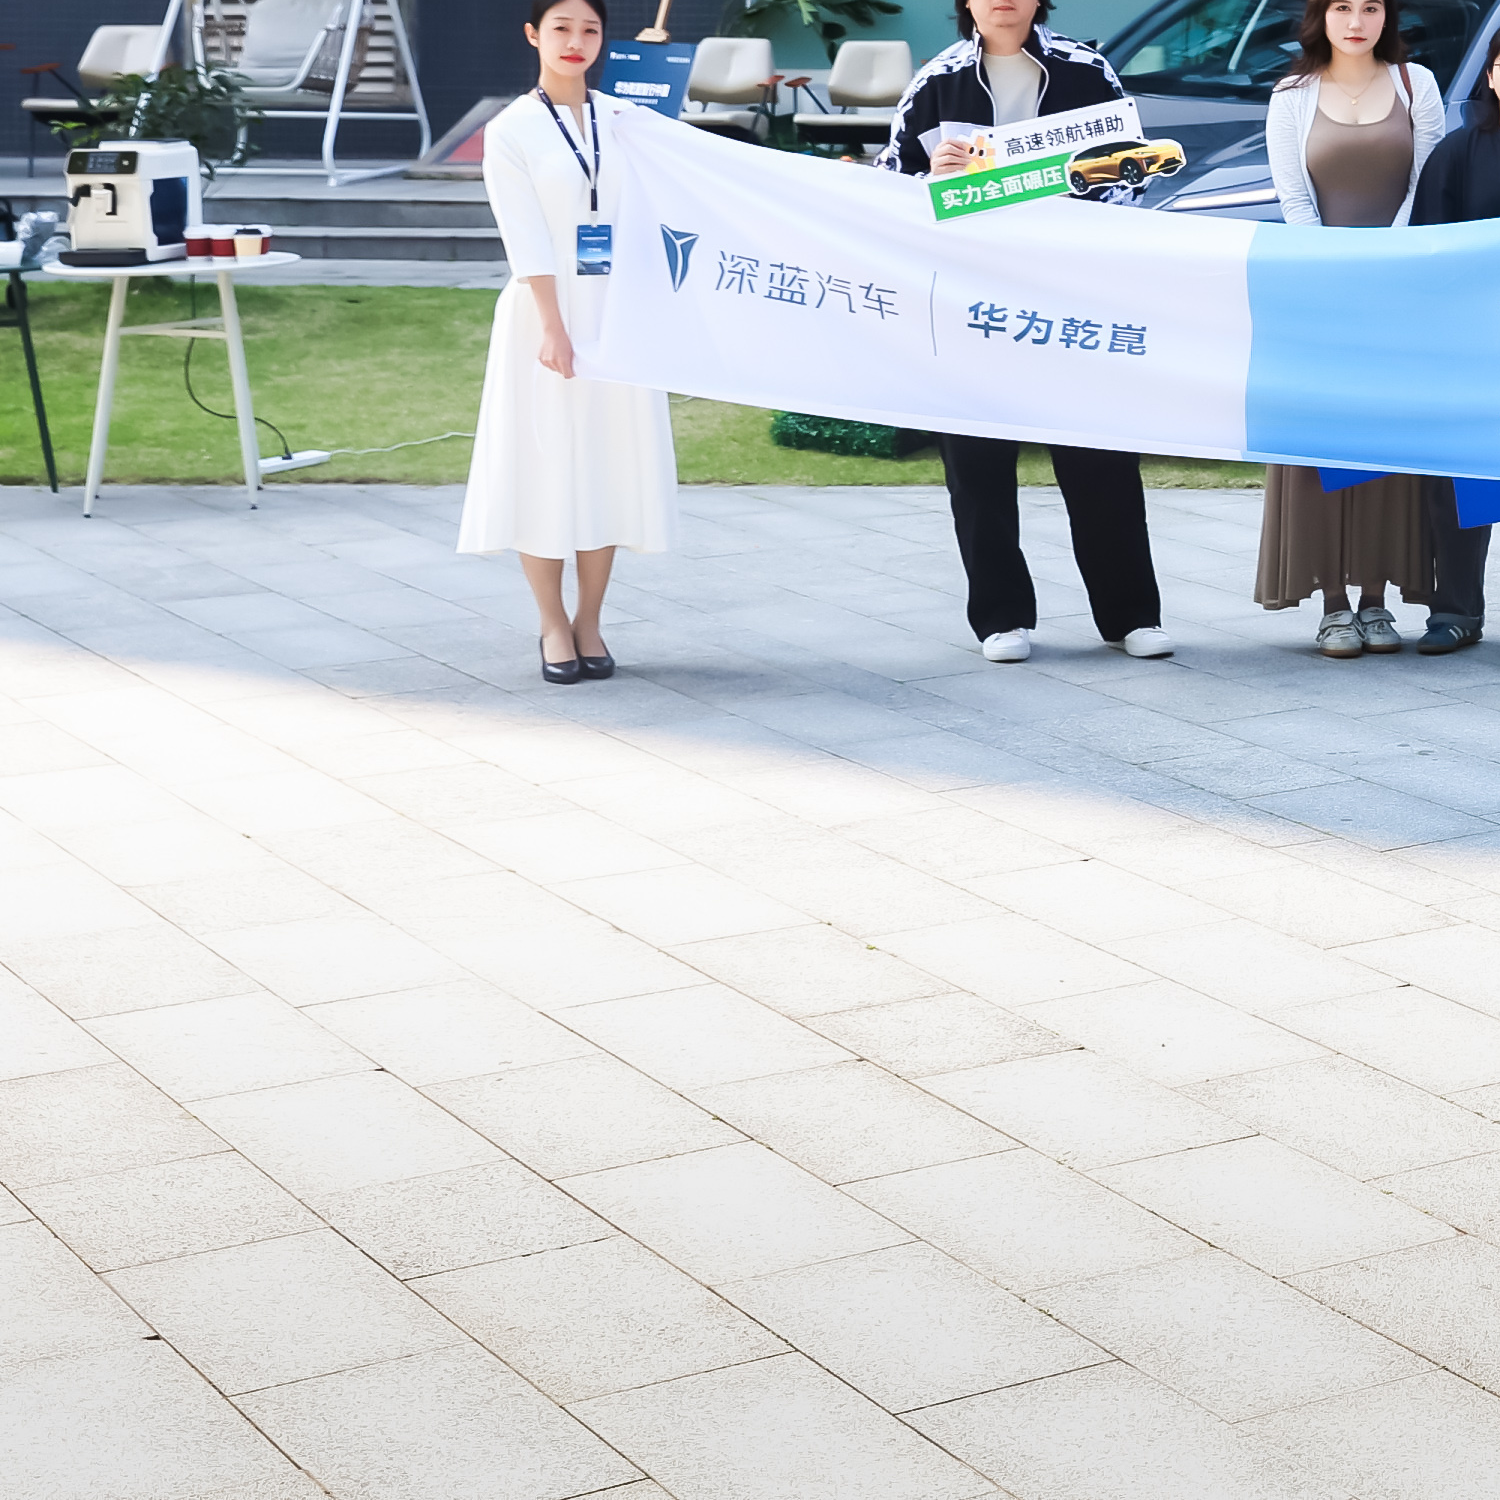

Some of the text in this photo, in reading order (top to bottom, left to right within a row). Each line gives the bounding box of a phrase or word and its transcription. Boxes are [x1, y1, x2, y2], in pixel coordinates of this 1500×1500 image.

[1004, 114, 1125, 157] 高速领航辅助
[940, 165, 1065, 211] 实力全面碾压
[715, 250, 1148, 357] 深蓝汽车 华为乾崑
